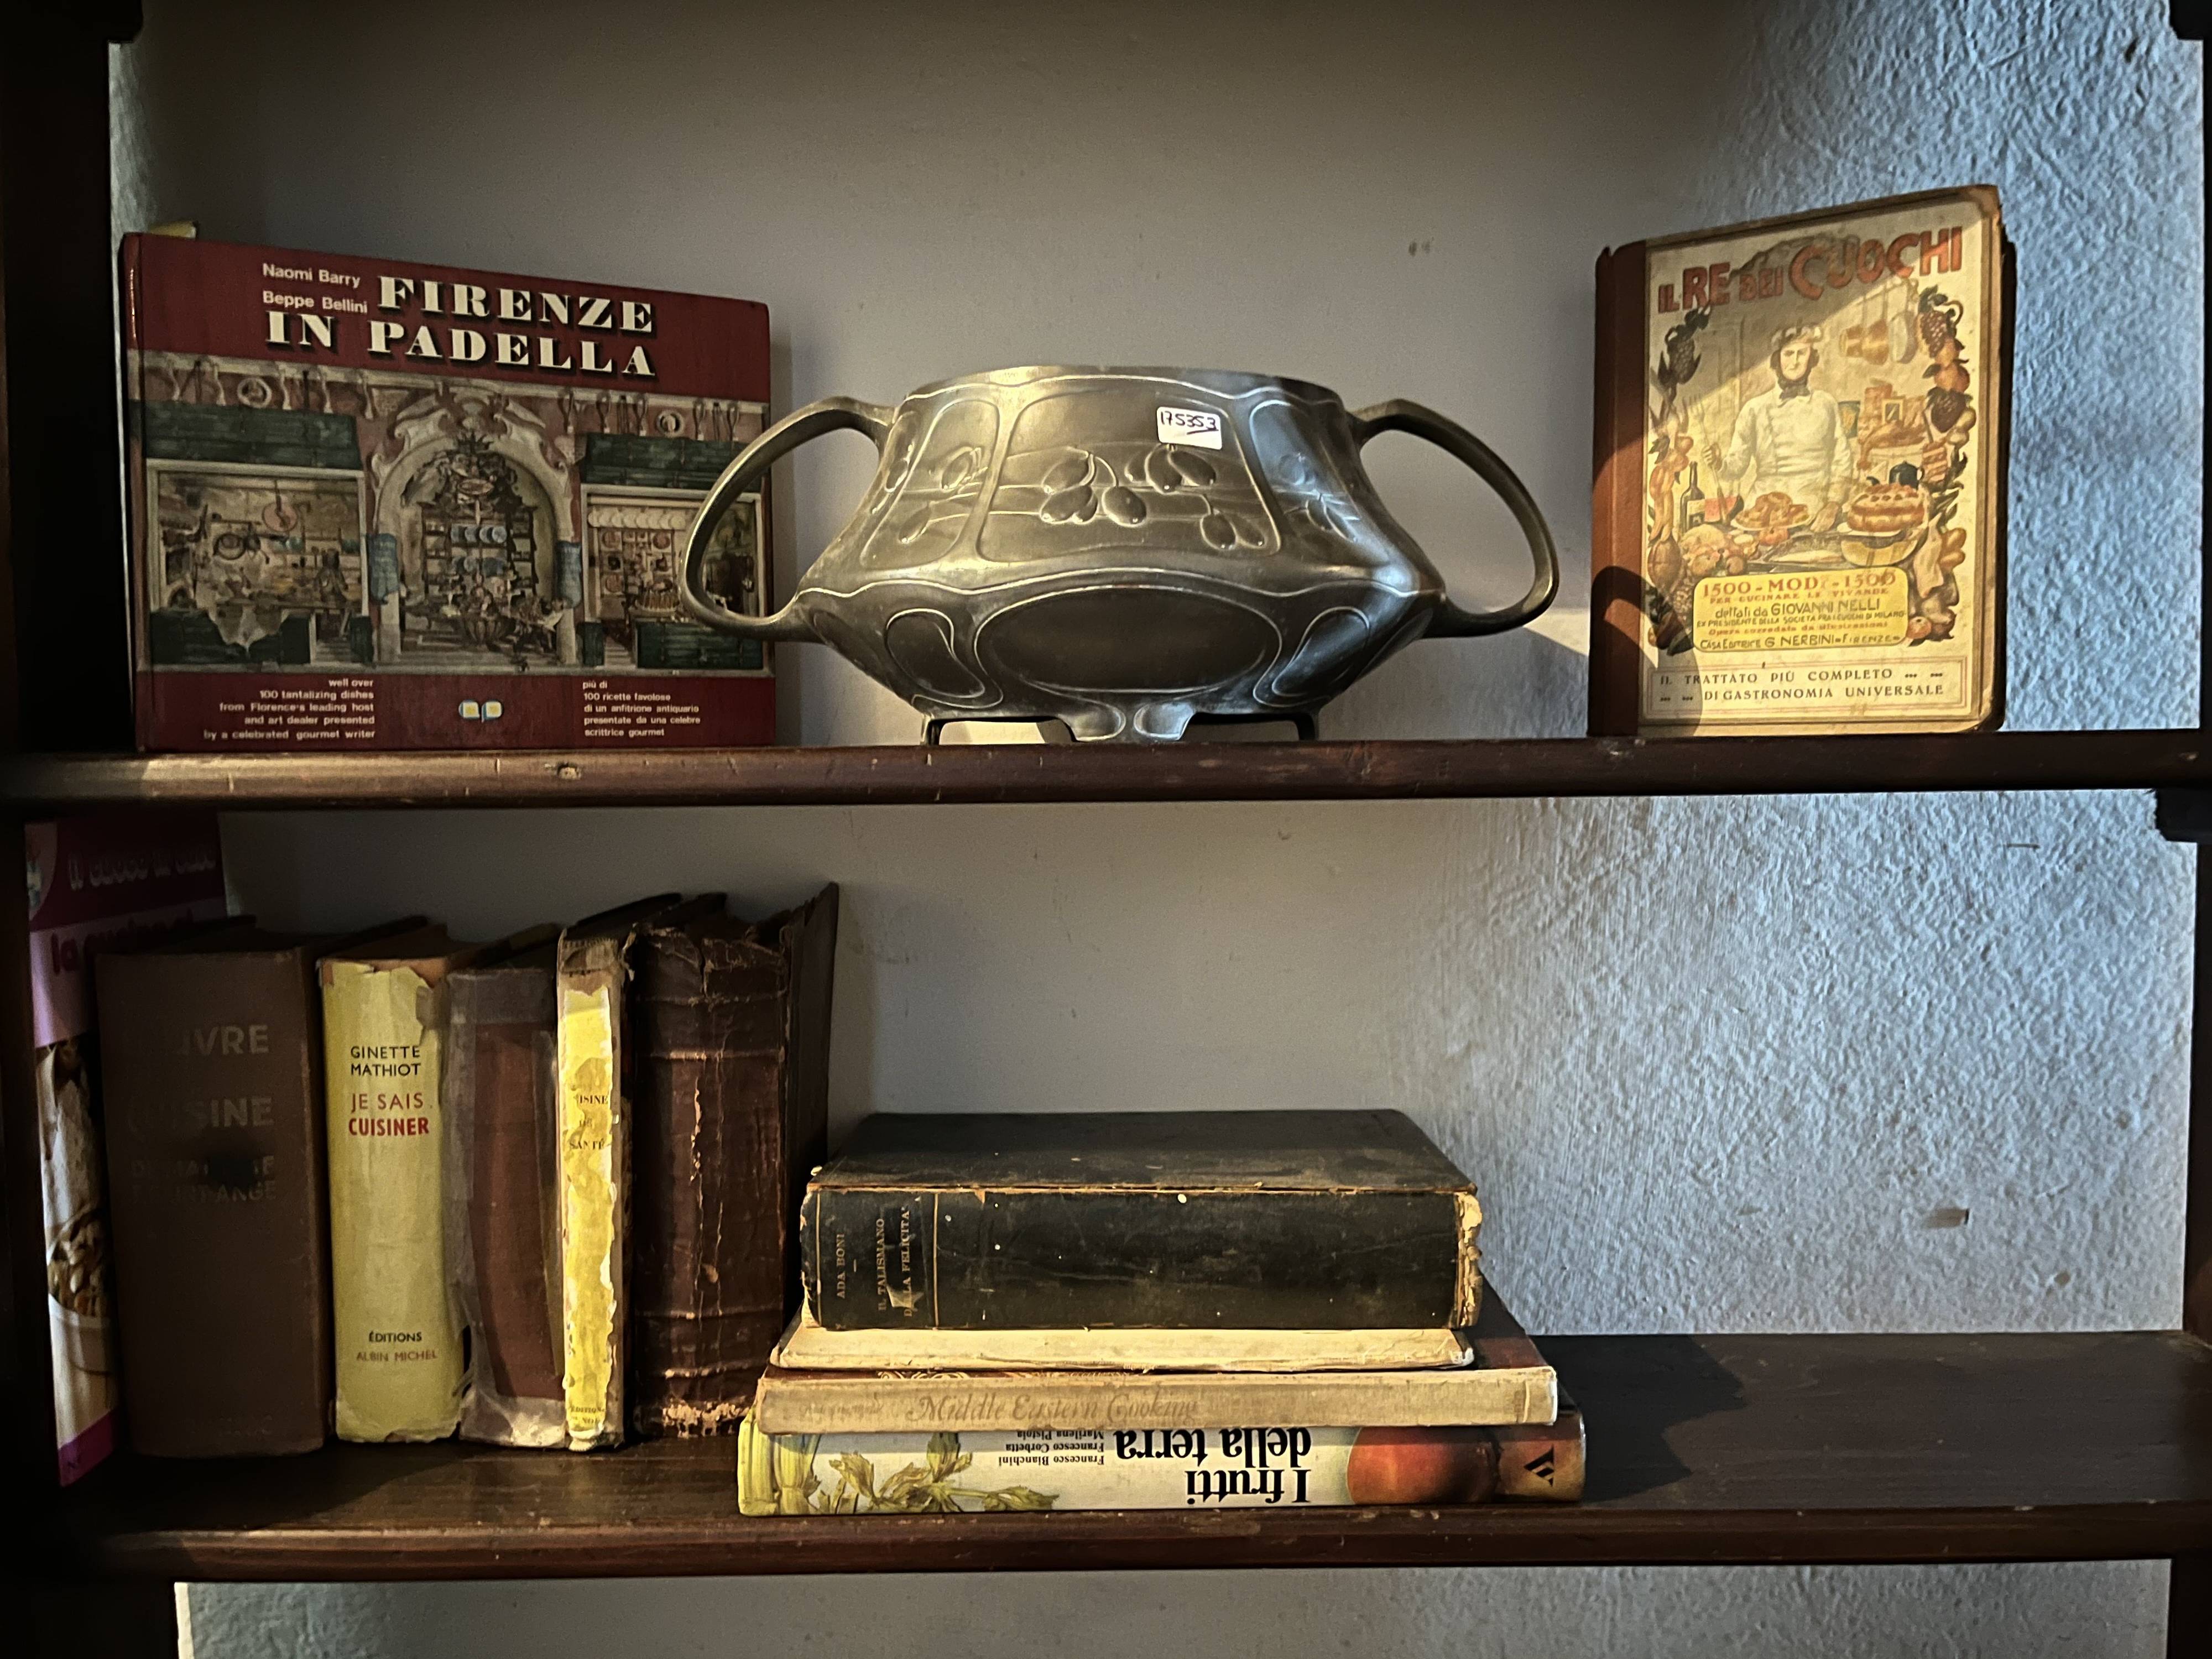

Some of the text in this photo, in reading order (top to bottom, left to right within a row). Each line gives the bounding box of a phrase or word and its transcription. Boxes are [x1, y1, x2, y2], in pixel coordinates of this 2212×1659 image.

[263, 263, 361, 289] Naomi Barry
[1658, 283, 1679, 314] IL
[1682, 262, 1731, 310] RE
[1788, 226, 1963, 301] CUOCHI
[263, 290, 368, 314] Beppe Bellini
[378, 276, 653, 332] FIRENZE
[266, 310, 656, 376] IN PADELLA
[1160, 410, 1218, 430] 175353
[1703, 581, 1751, 597] 1500
[1845, 571, 1896, 588] 1500
[1753, 607, 1768, 617] da
[1771, 601, 1834, 616] GIOVANNI
[1838, 598, 1880, 613] NELLI
[328, 679, 348, 687] well
[599, 681, 608, 689] di
[1660, 675, 1672, 685] IL
[1684, 673, 1757, 685] TRATTATO
[1808, 668, 1892, 681] COMPLETO
[260, 690, 374, 701] 100 tantalizing dishes
[583, 692, 671, 701] 100 ricette favolose
[1704, 684, 1944, 701] DI GASTRONOMIA UNIVERSALE
[220, 702, 244, 711] from
[309, 703, 347, 713] leading
[352, 703, 374, 712] host
[583, 704, 592, 713] di
[611, 704, 653, 713] anfitrione
[656, 704, 700, 714] antiquario
[244, 715, 375, 726] and art dealer presented
[583, 716, 632, 726] presentate
[636, 715, 647, 724] da
[670, 716, 701, 724] celebre
[203, 729, 217, 740] by
[232, 730, 289, 739] celebrated
[296, 730, 340, 740] gourmet
[345, 730, 375, 738] writer
[585, 728, 665, 738] scrittrice gourmet
[178, 1024, 269, 1056] IVRE
[351, 1046, 421, 1059] GINETTE
[351, 1063, 421, 1076] MATHIOT
[351, 1092, 424, 1114] JE SAIS
[348, 1117, 430, 1136] CUISINER
[876, 1218, 885, 1295] TALISMANO
[836, 1234, 846, 1299] ADA BONI
[902, 1276, 912, 1317] DLA
[369, 1331, 422, 1343] ÉDITIONS
[356, 1349, 438, 1361] ALBIN MICHEL
[905, 1392, 1005, 1422] Middle
[1013, 1393, 1098, 1421] Eastern
[1108, 1389, 1198, 1426] Cooking
[1016, 1430, 1104, 1441] Marilena Pistoia
[1005, 1443, 1104, 1453] Francesco Corbetta
[1113, 1428, 1312, 1468] della terra
[998, 1455, 1104, 1467] Francesco Bianchini
[1186, 1469, 1312, 1504] I frutti
